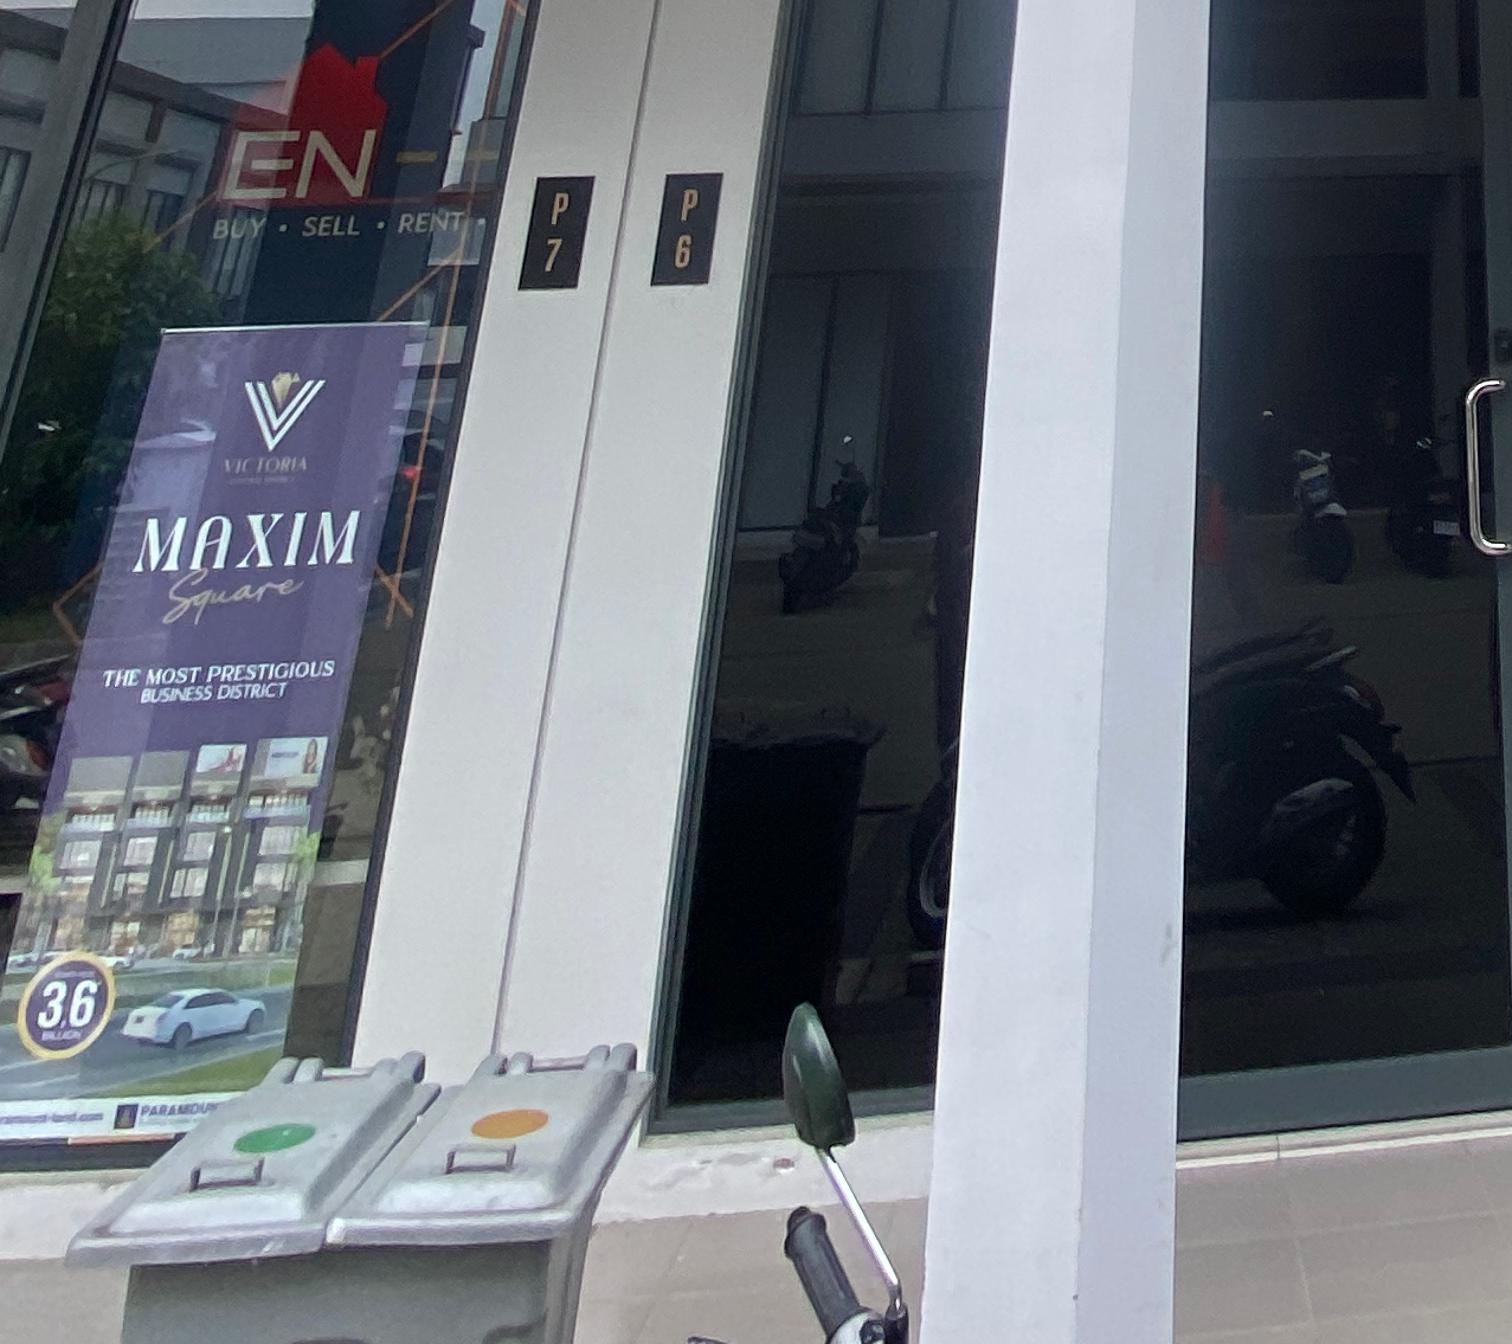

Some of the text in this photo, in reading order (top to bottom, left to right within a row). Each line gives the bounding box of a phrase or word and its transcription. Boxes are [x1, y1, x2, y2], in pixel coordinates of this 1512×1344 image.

[212, 211, 466, 240] BUY SELL RENT
[223, 455, 308, 476] VICTORIA
[131, 509, 361, 574] MAXIM
[162, 567, 305, 625] Square
[102, 660, 336, 688] THE MOST PRESTIGIOUS
[140, 681, 288, 705] BUSINESS DISTRICT
